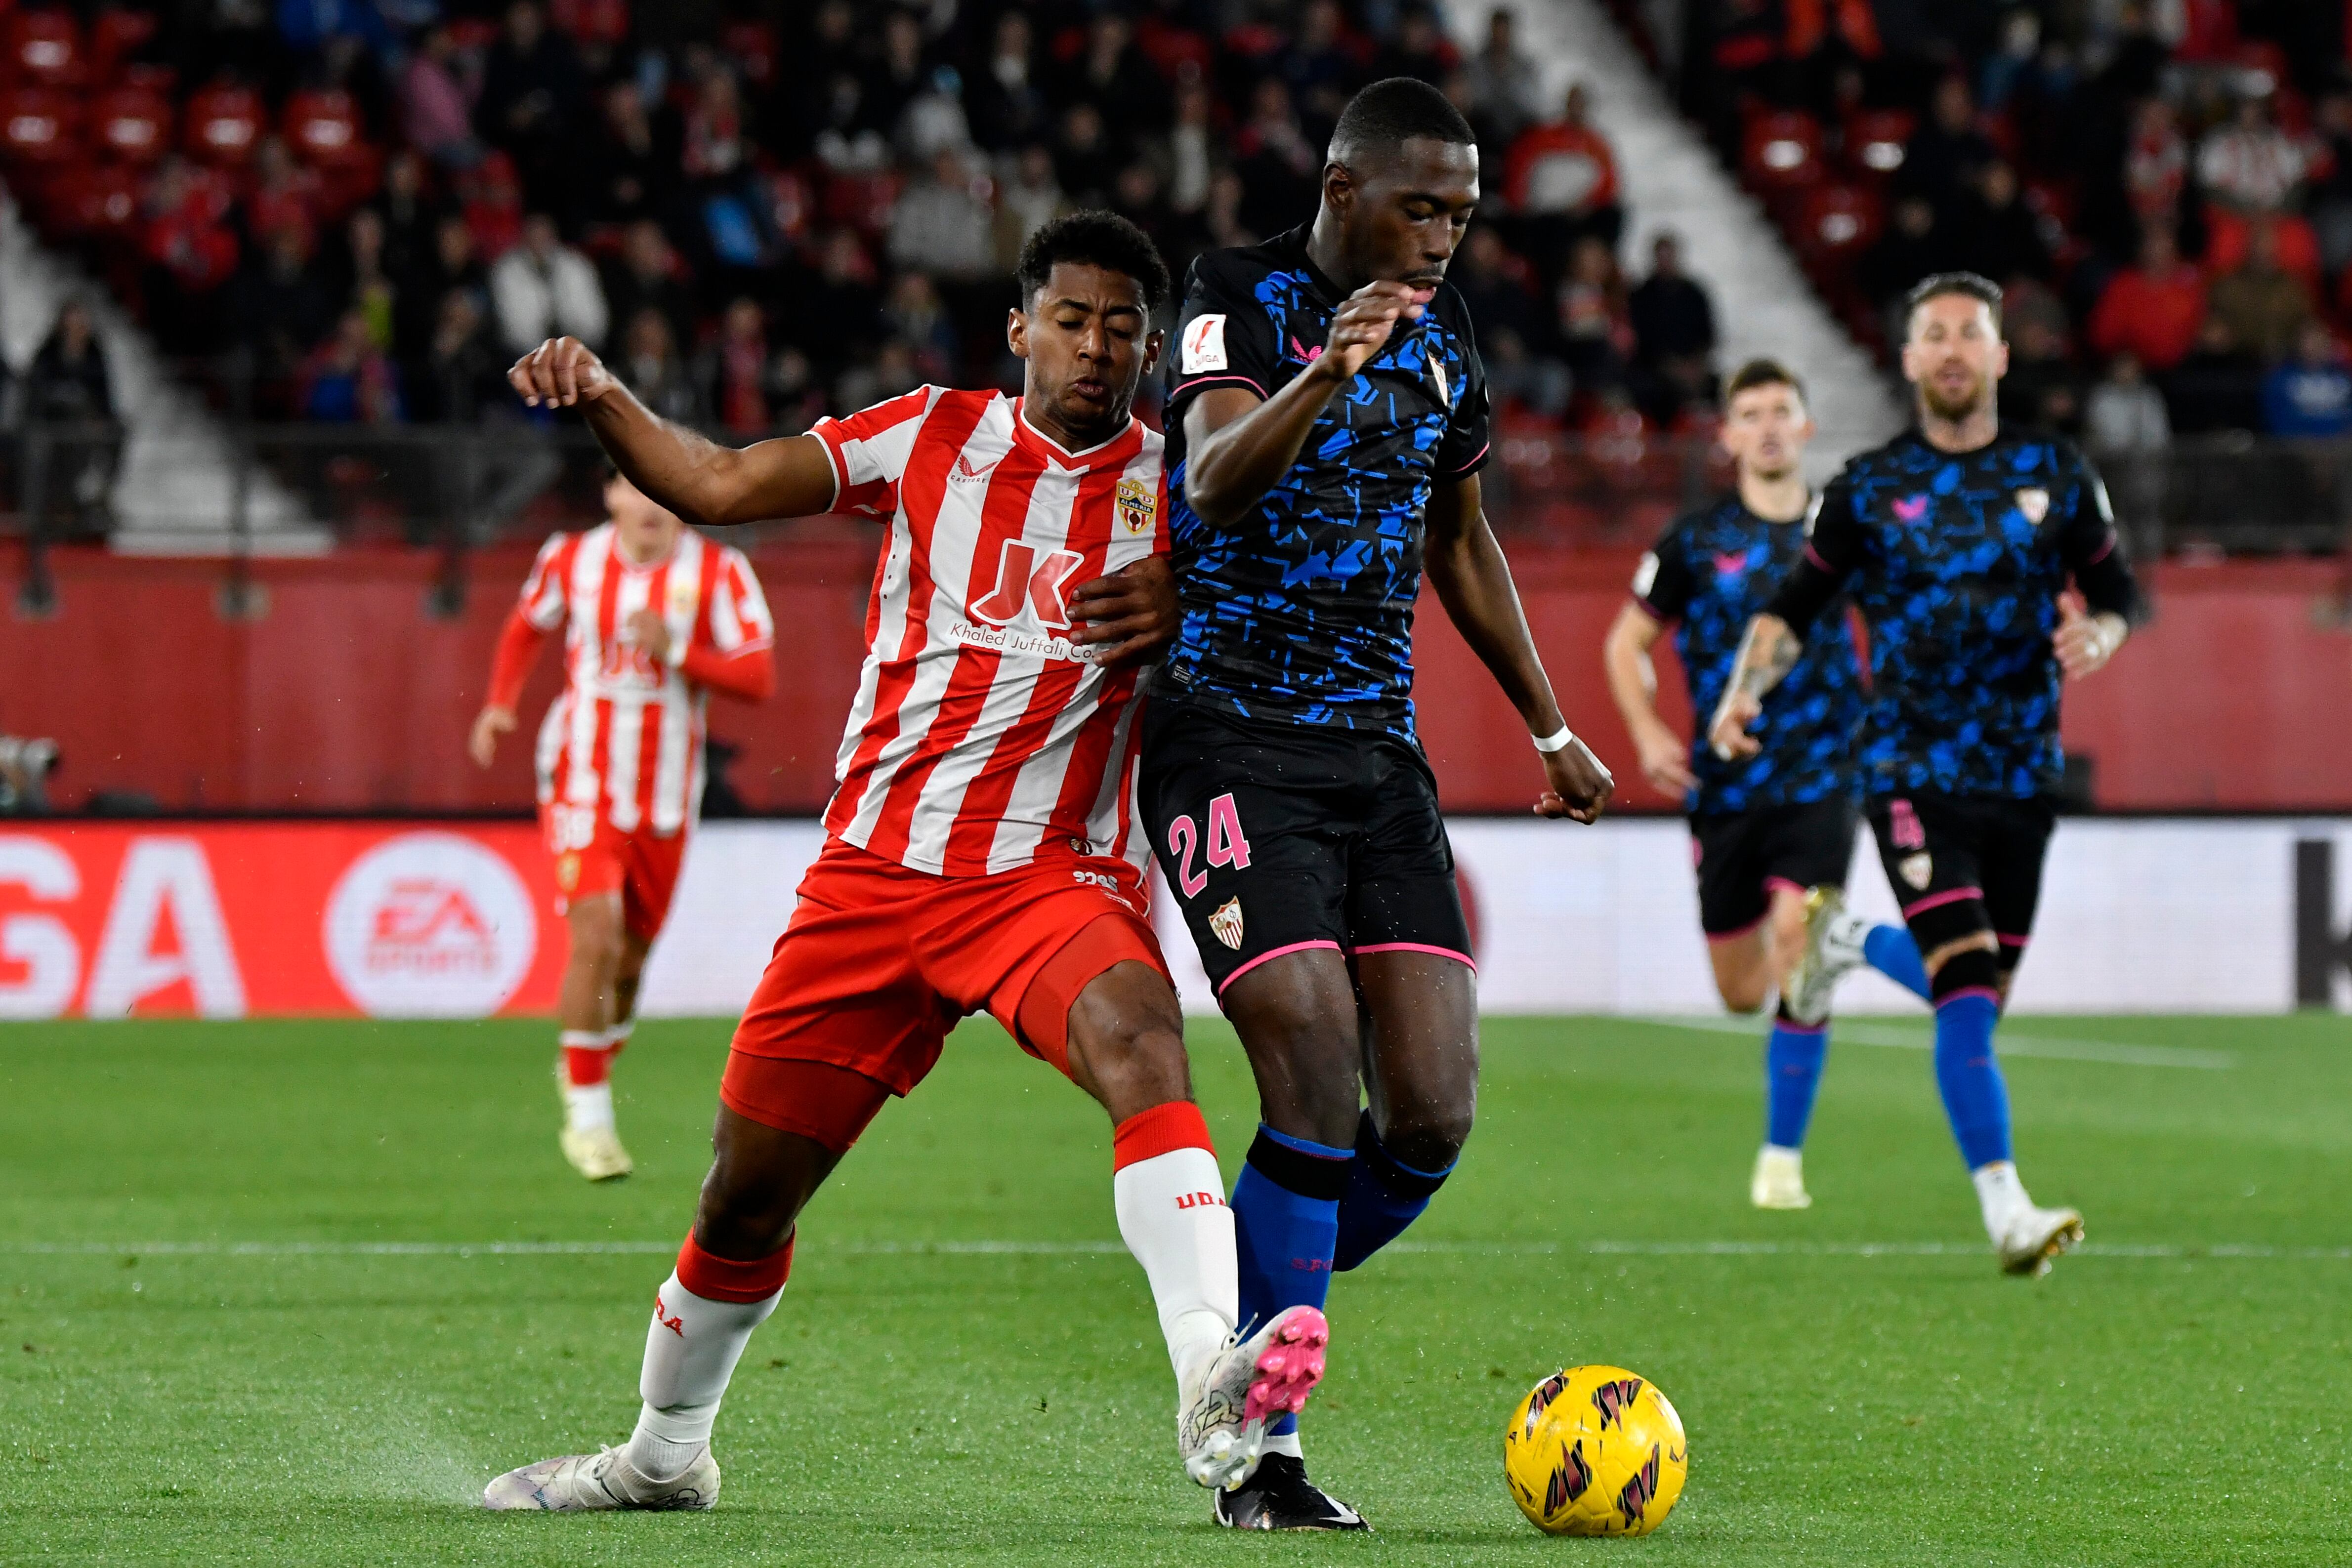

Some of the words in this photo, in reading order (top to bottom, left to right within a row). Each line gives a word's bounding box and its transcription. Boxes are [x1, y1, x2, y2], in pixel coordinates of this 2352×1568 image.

[1121, 499, 1151, 513] ALMERIA
[973, 540, 1082, 627] JK
[950, 622, 1007, 646] Khaled
[1010, 636, 1065, 656] Juffali
[1168, 792, 1252, 900] 24
[371, 877, 494, 945] EA
